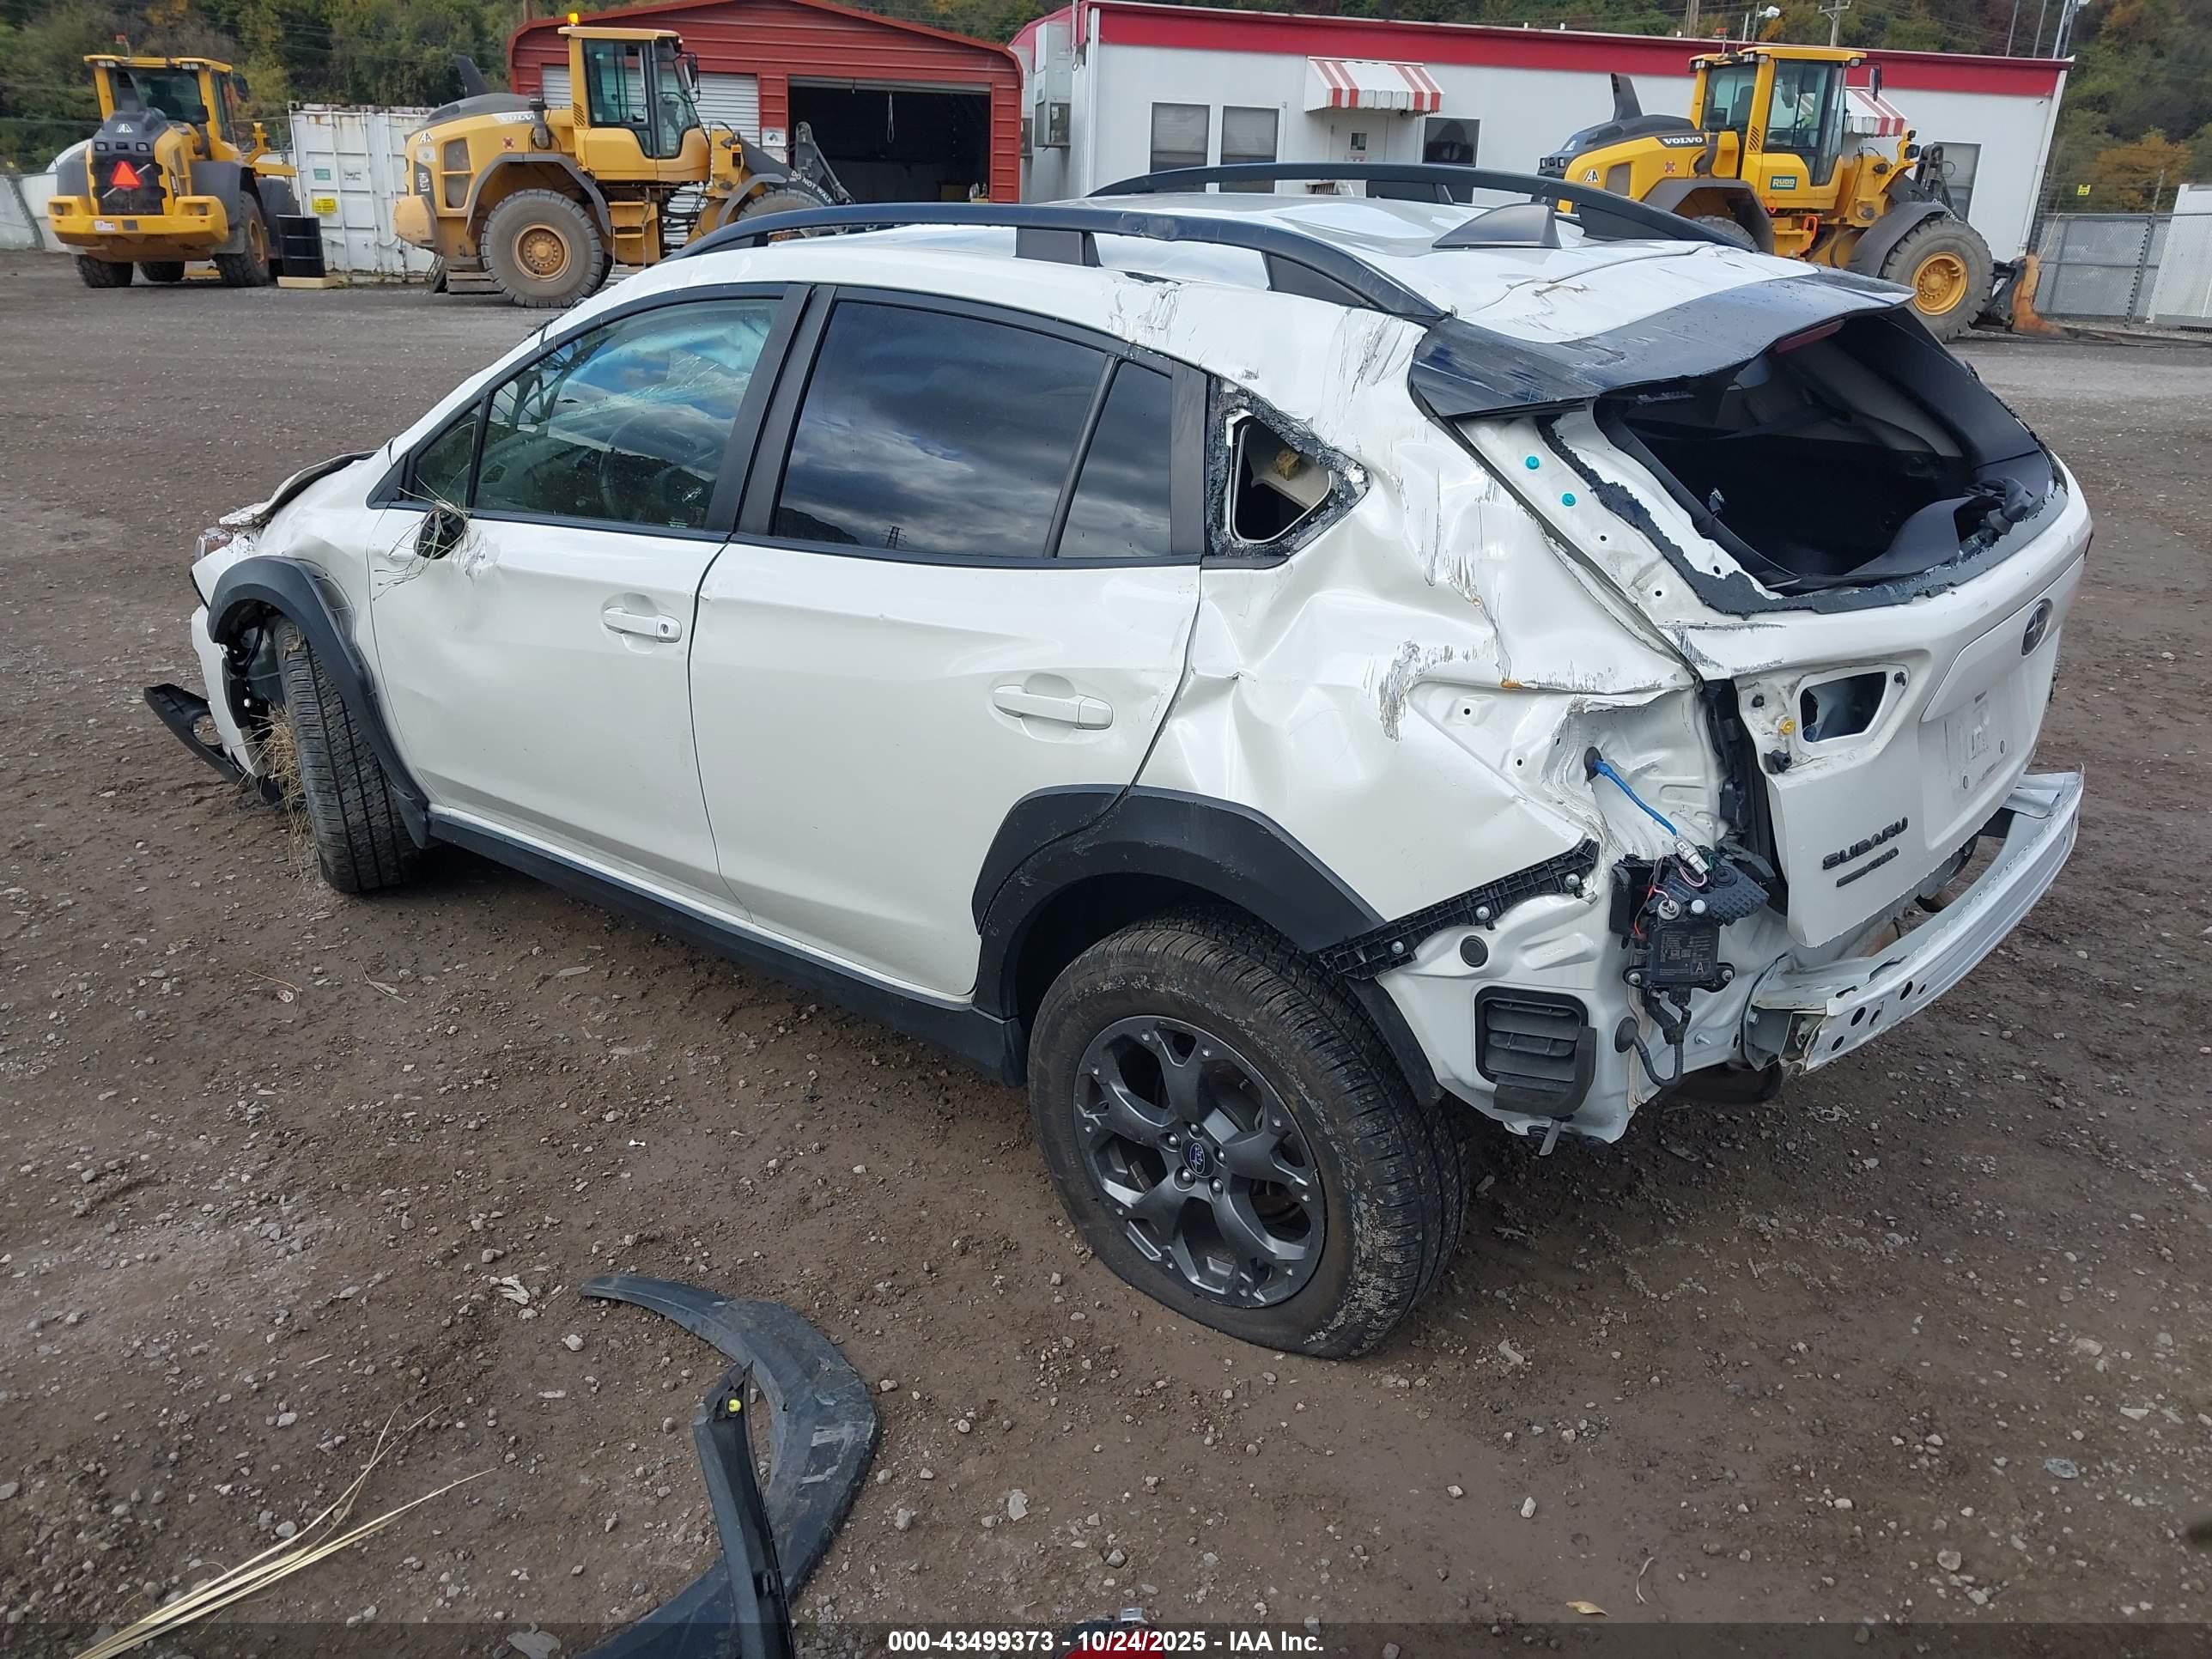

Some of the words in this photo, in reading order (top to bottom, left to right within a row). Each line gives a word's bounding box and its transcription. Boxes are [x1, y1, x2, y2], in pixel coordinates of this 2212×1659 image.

[1662, 137, 1704, 145] VOLVO
[791, 170, 802, 180] DO
[802, 177, 817, 190] NOT
[817, 187, 833, 204] WALK
[1772, 178, 1796, 188] RUDD
[1822, 817, 1908, 870] SUBARU
